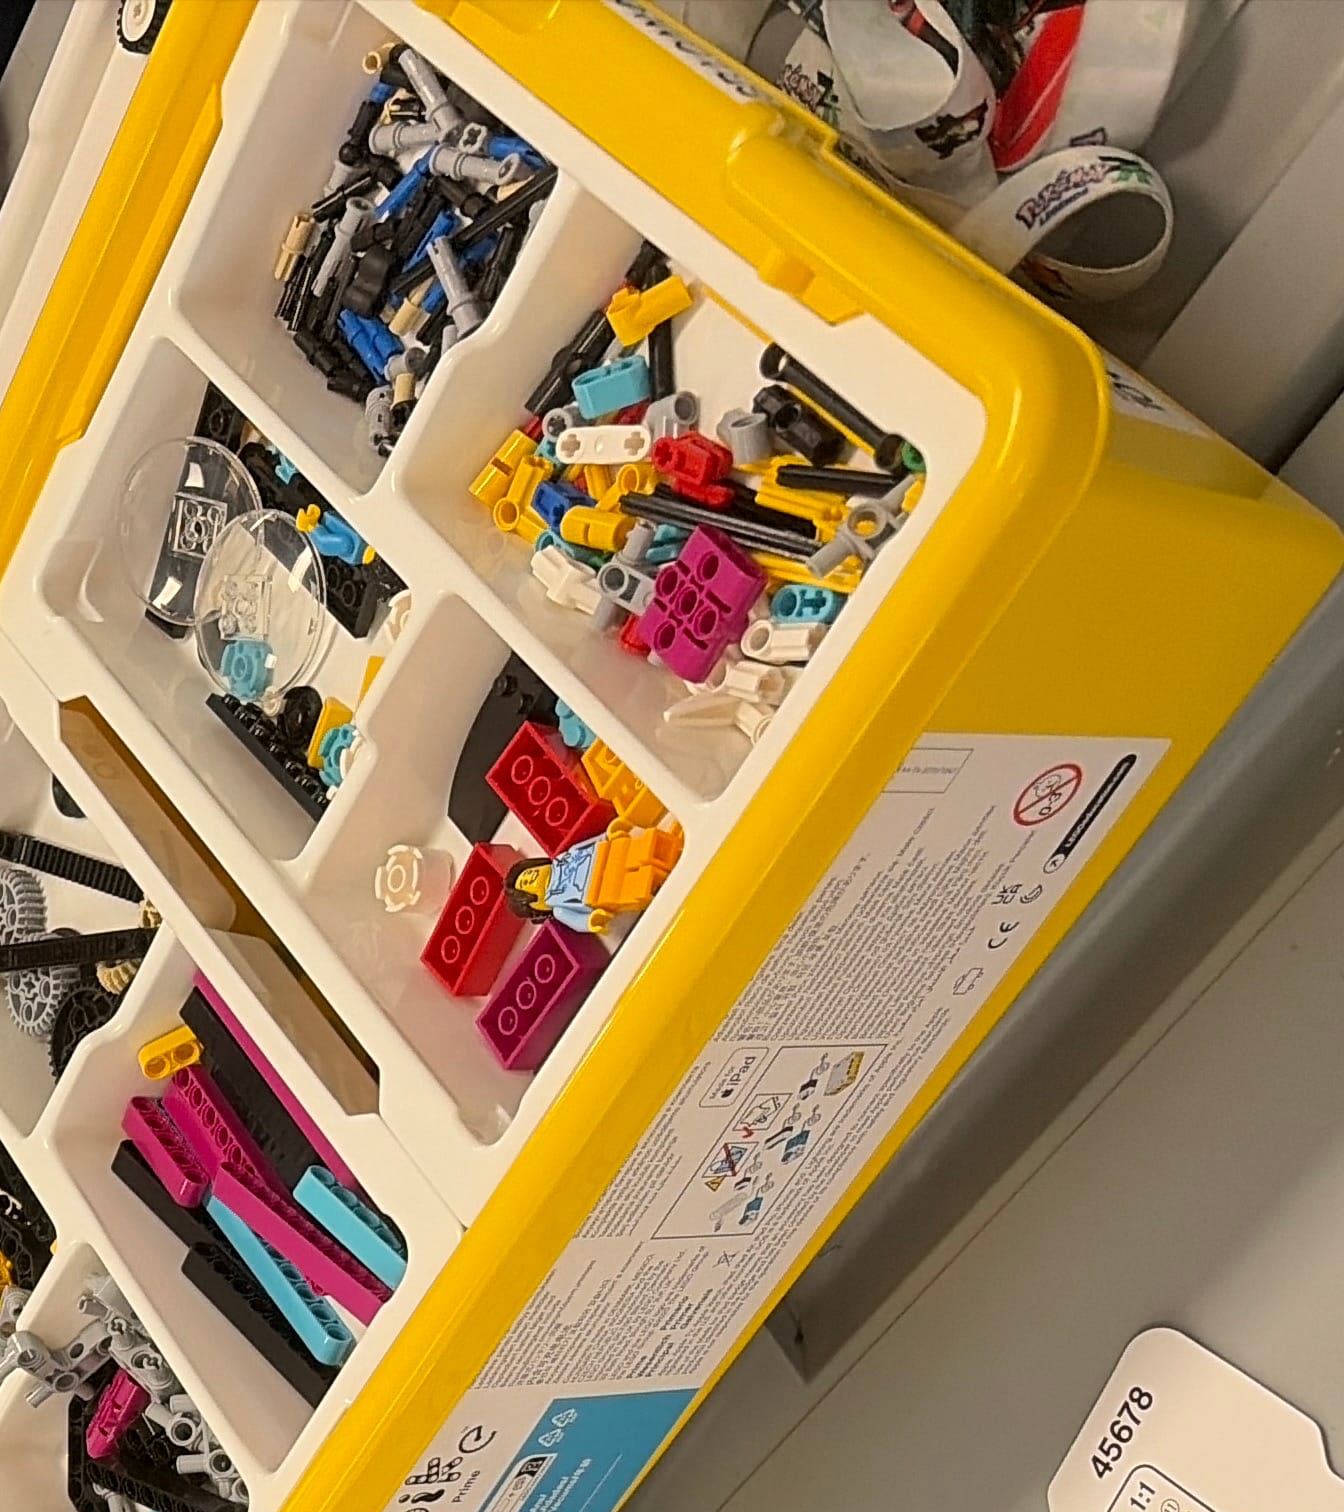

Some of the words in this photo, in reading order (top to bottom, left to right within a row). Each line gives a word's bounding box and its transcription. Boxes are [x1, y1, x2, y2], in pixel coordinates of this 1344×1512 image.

[726, 1056, 757, 1086] iPad
[1091, 1386, 1152, 1479] 45678
[450, 1470, 481, 1503] Prime
[1129, 1481, 1156, 1512] 1:1
